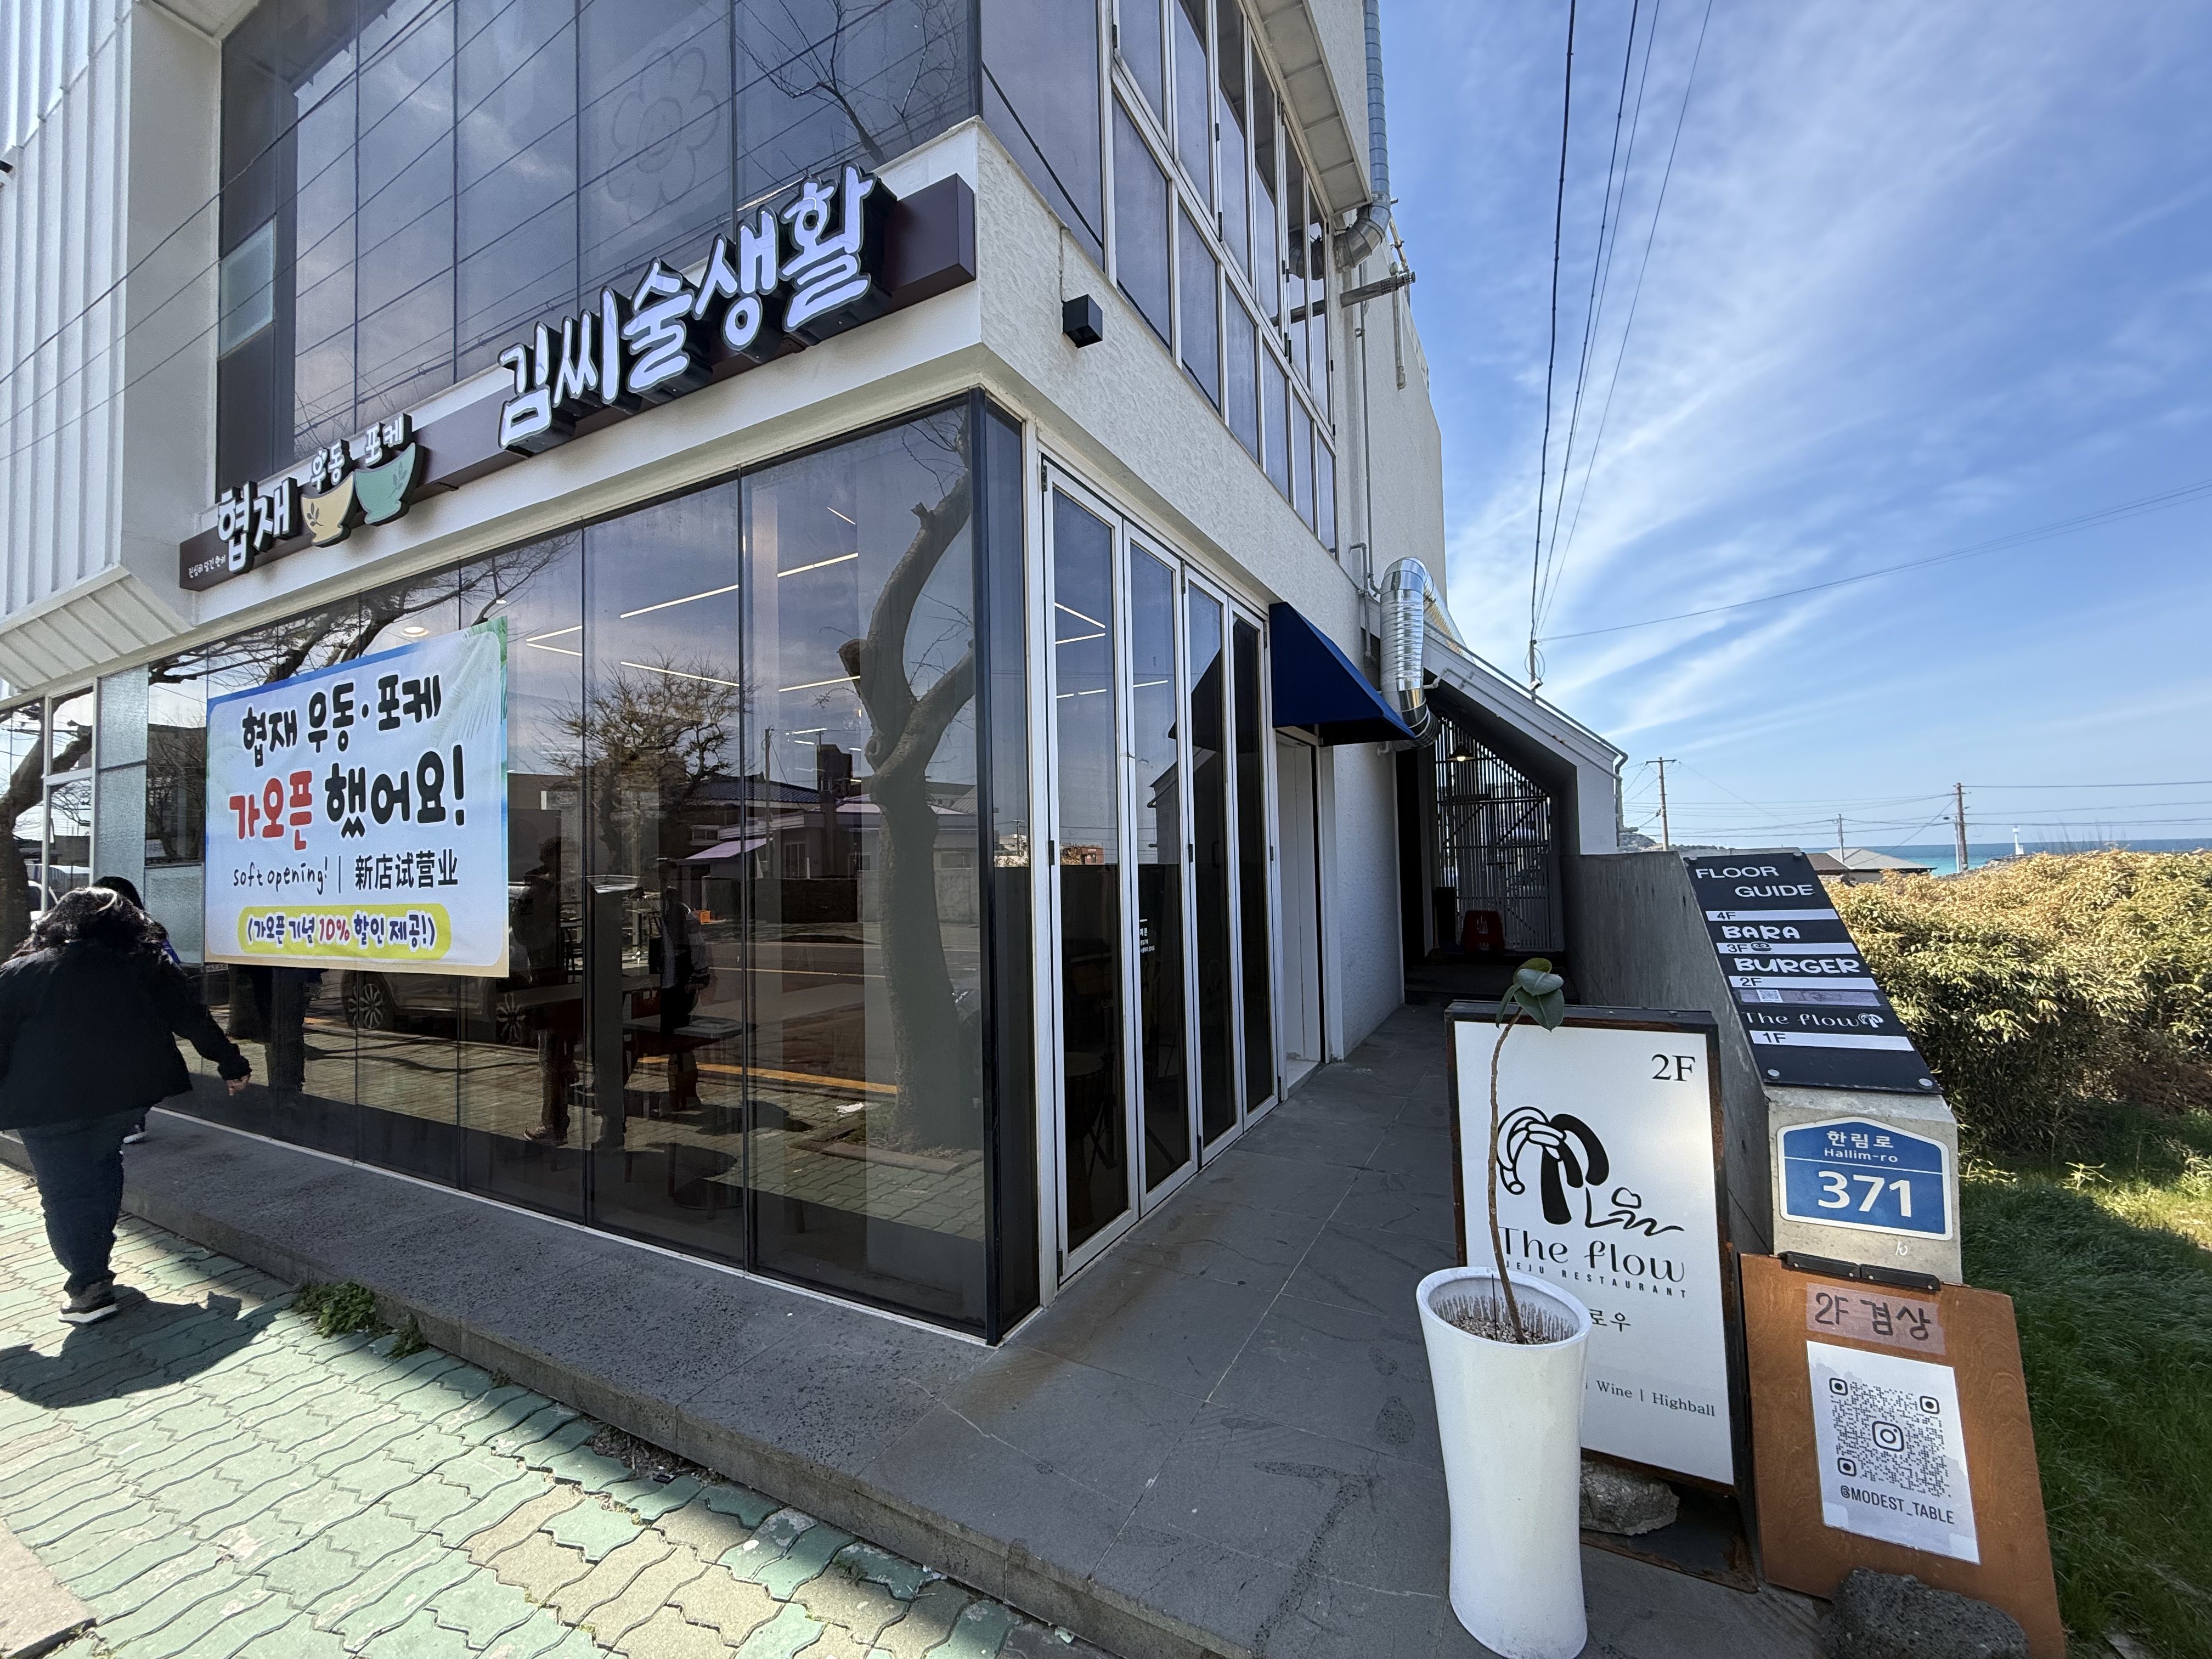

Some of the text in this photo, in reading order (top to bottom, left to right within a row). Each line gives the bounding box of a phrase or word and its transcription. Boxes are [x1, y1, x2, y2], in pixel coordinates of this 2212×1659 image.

[498, 162, 877, 449] 김씨술생활
[311, 413, 404, 492] 우동 포케
[218, 477, 291, 573] 협재
[241, 707, 298, 768] 협재
[229, 770, 313, 851] 가오픈
[234, 856, 329, 896] soft opening!
[354, 849, 459, 890] 新店试营业
[1696, 866, 1780, 879] FLOOR
[1735, 884, 1816, 898] GUIDE
[247, 914, 436, 950] (가오픈 기념 10% 할인 제공!)
[1717, 912, 1737, 921] 4F
[1722, 926, 1801, 939] BARA
[1726, 944, 1748, 953] 3F
[1734, 958, 1861, 974] BURGER
[1740, 977, 1763, 986] 2F
[1741, 1012, 1859, 1028] The flow
[1762, 1032, 1787, 1043] 1F
[1651, 1053, 1696, 1082] 2F
[1824, 1148, 1898, 1163] Hallim-ro
[1826, 1130, 1894, 1148] 한림로
[1818, 1170, 1912, 1217] 371
[1498, 1226, 1685, 1283] The flow
[1506, 1260, 1686, 1299] JEJU RESTAURANT
[1813, 1291, 1932, 1341] 2F 겸상
[1595, 1380, 1716, 1417] Wine Highball
[1840, 1485, 1955, 1525] @MODEST_TABLE
